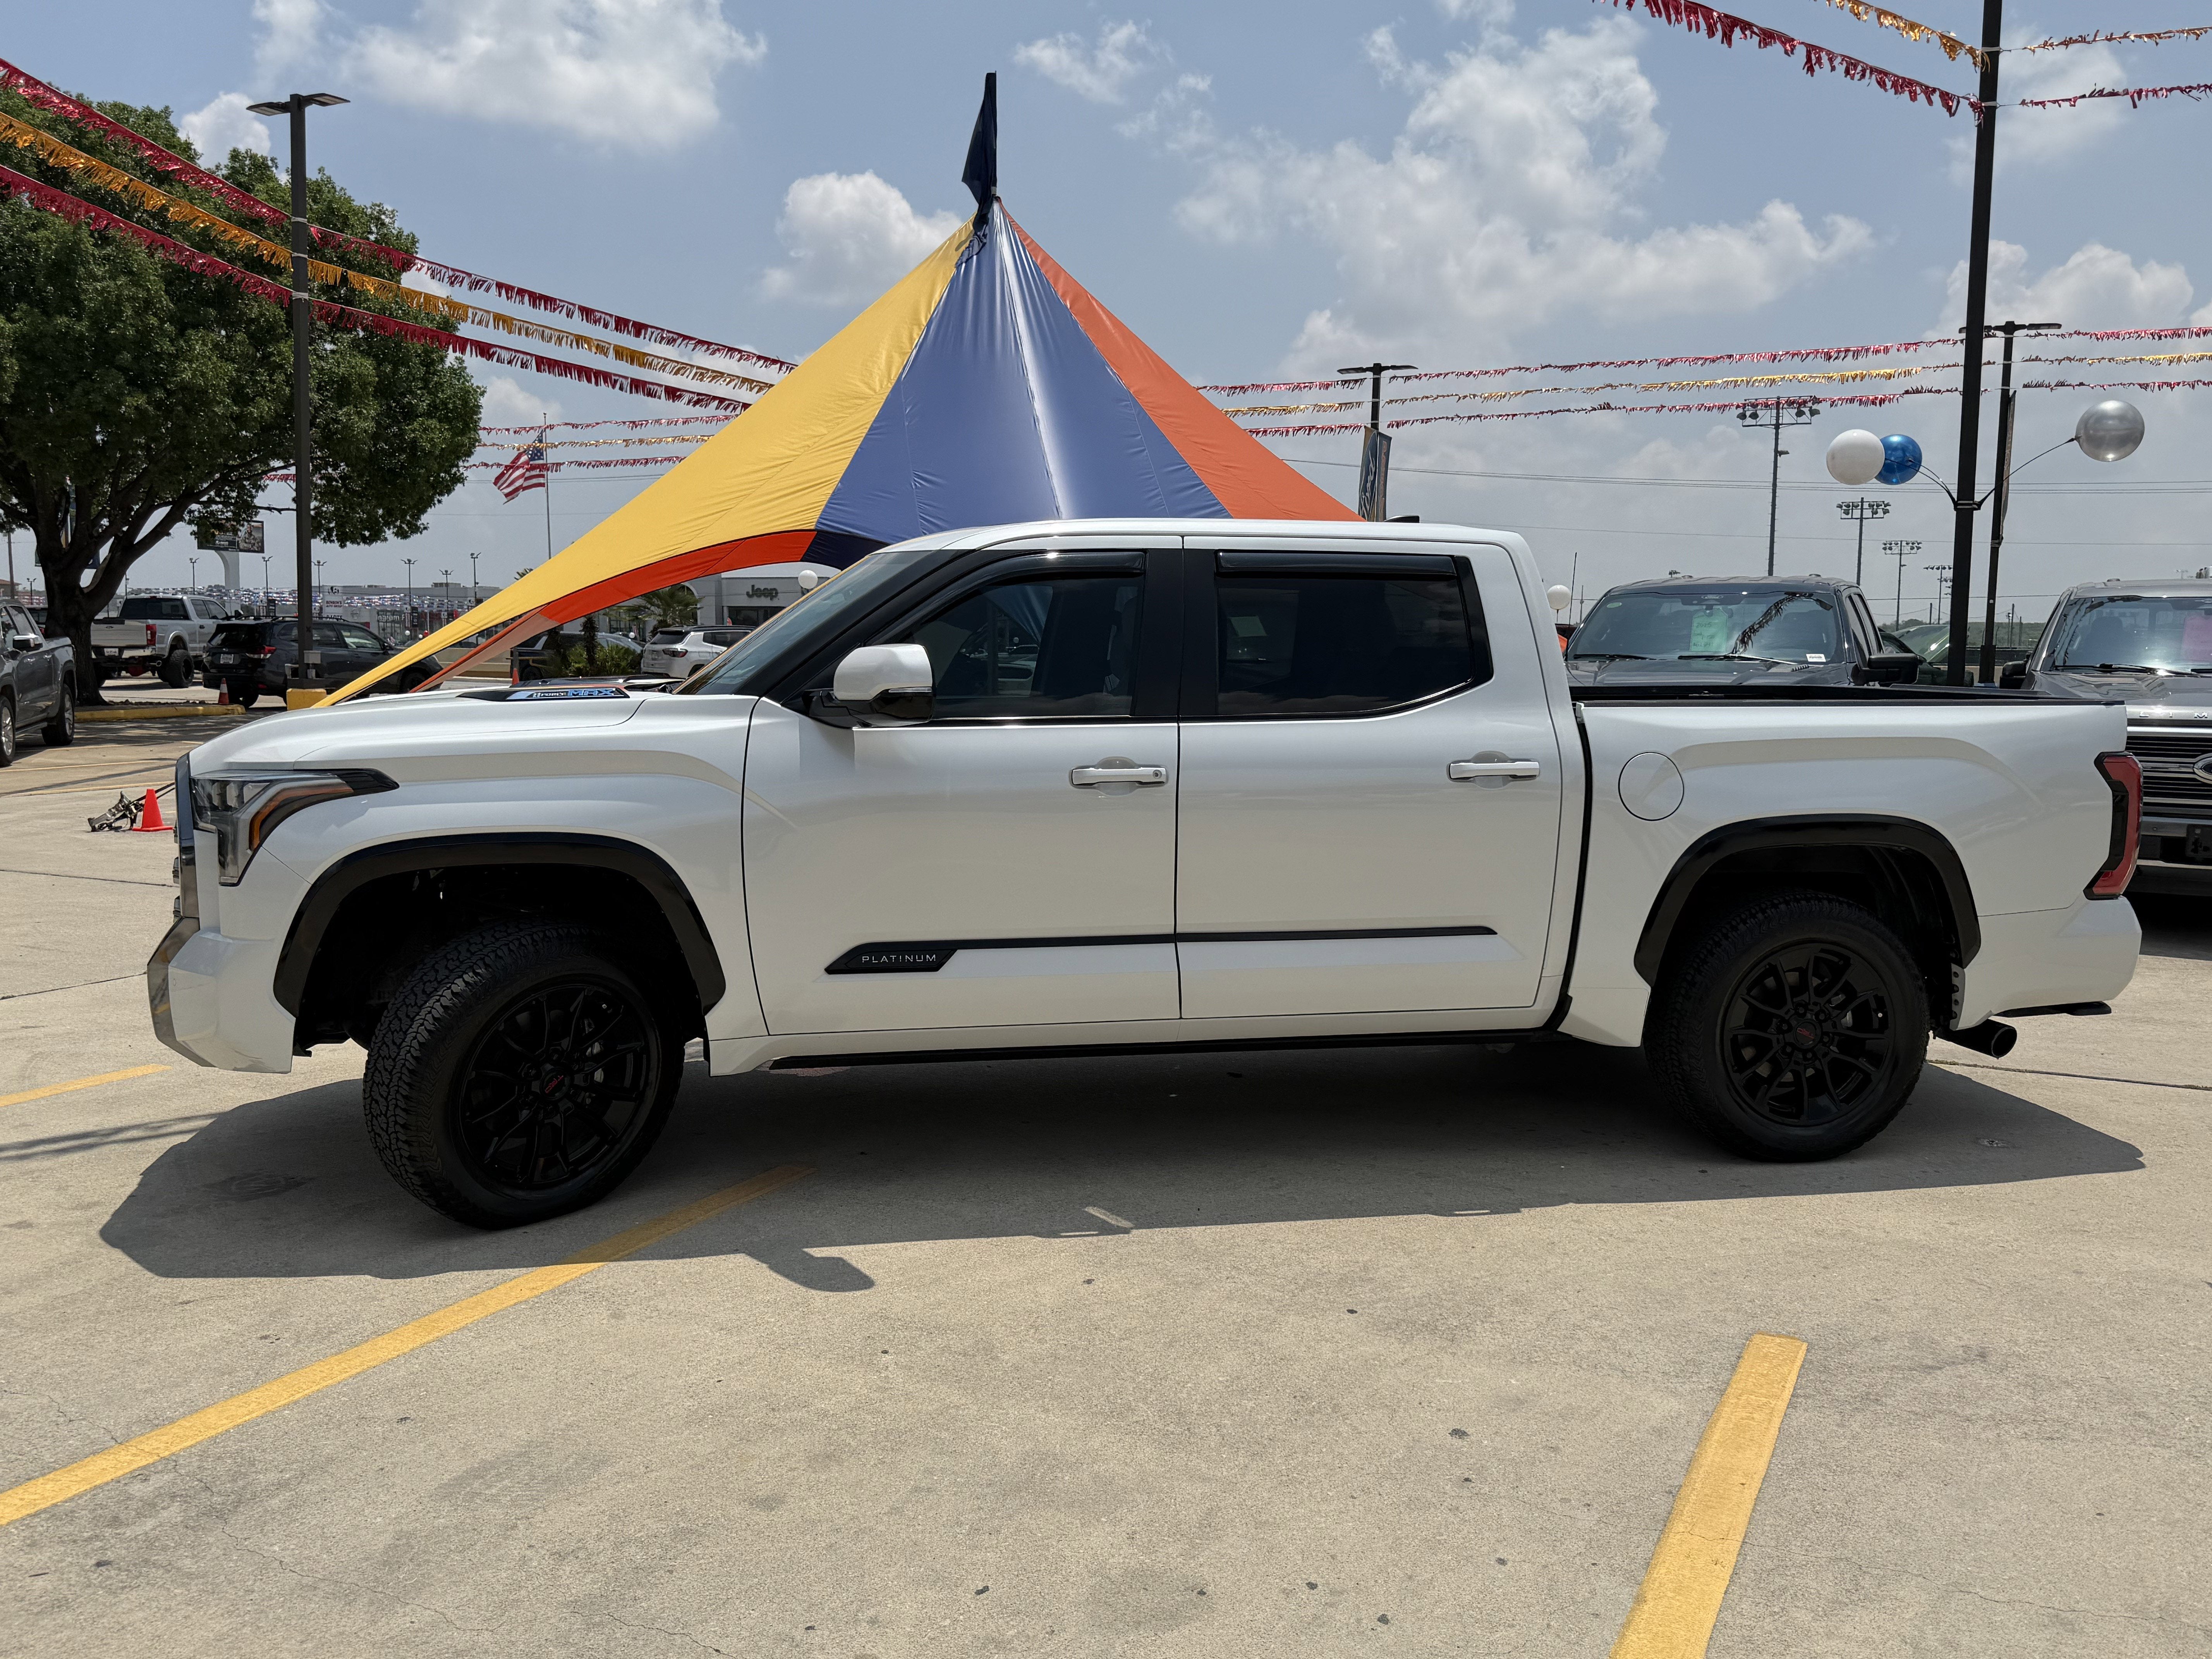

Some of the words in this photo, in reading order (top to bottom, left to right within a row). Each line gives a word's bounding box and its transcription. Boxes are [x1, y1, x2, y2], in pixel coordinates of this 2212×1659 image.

[746, 584, 779, 601] Jeep
[568, 688, 615, 696] MAX
[862, 954, 936, 963] PLATINUM
